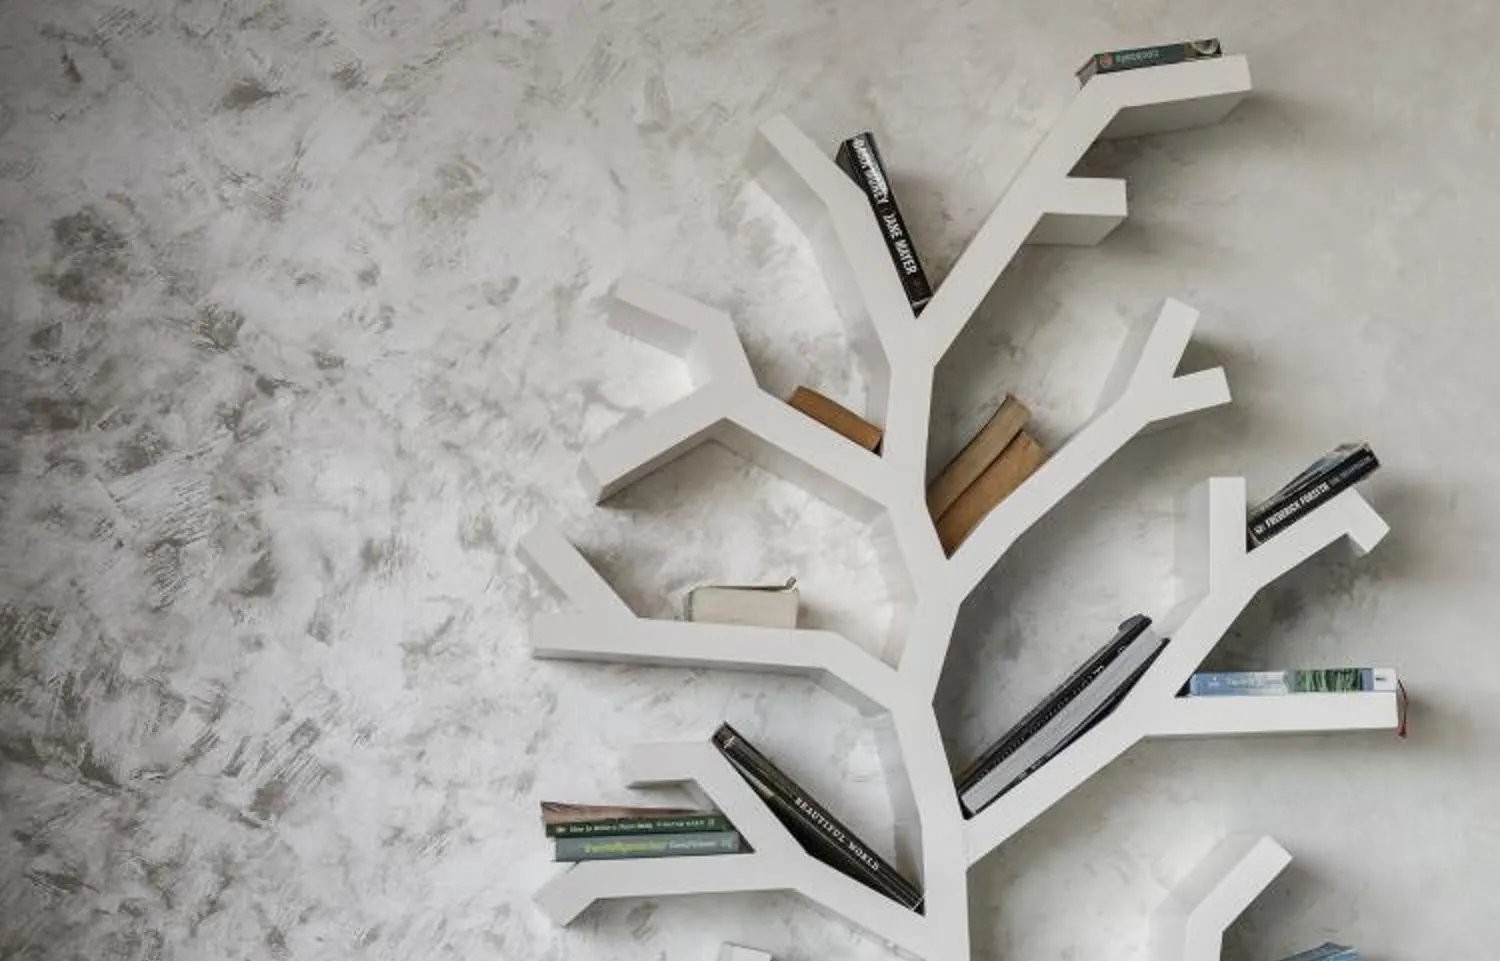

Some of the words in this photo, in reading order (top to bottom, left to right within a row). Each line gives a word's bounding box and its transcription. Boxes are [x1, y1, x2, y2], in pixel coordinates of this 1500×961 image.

[883, 213, 903, 239] JANE
[895, 239, 918, 275] MAYER
[795, 796, 847, 843] BEAUTIFUL
[849, 841, 881, 871] WORLD
